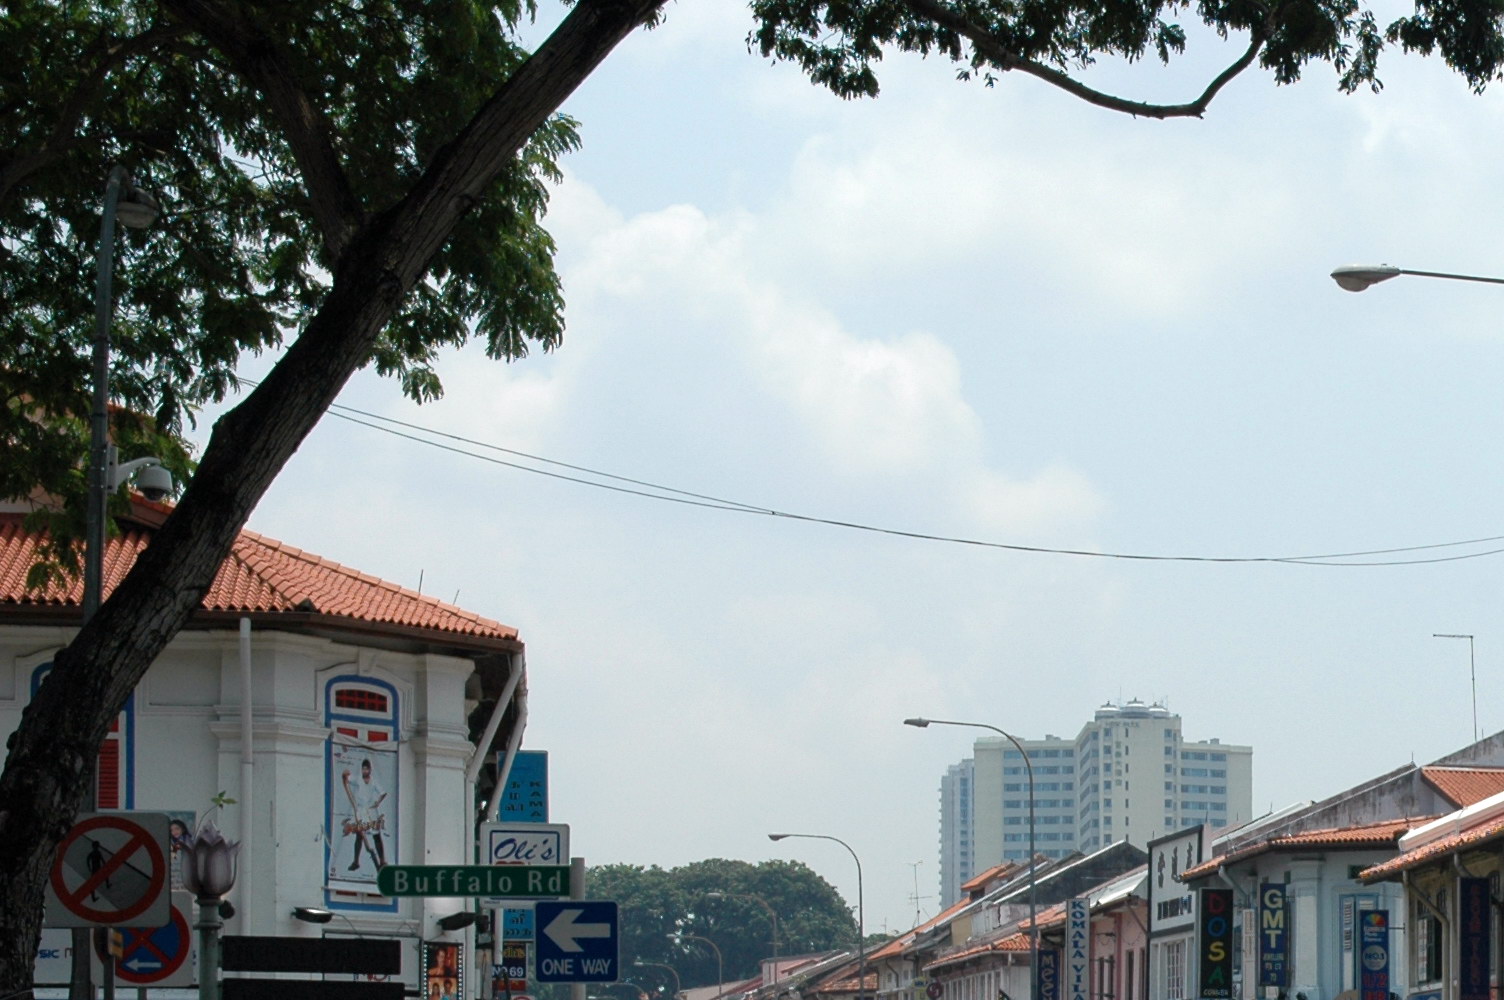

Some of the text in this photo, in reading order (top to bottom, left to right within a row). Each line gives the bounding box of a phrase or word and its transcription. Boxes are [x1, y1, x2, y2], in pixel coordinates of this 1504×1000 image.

[494, 838, 555, 861] Oli's
[393, 869, 562, 893] Buffalo Rd
[1071, 901, 1086, 959] KOMALA
[1263, 888, 1284, 949] GMT
[1207, 893, 1227, 985] DOSA
[509, 966, 524, 977] 69
[542, 958, 612, 976] ONE WAY
